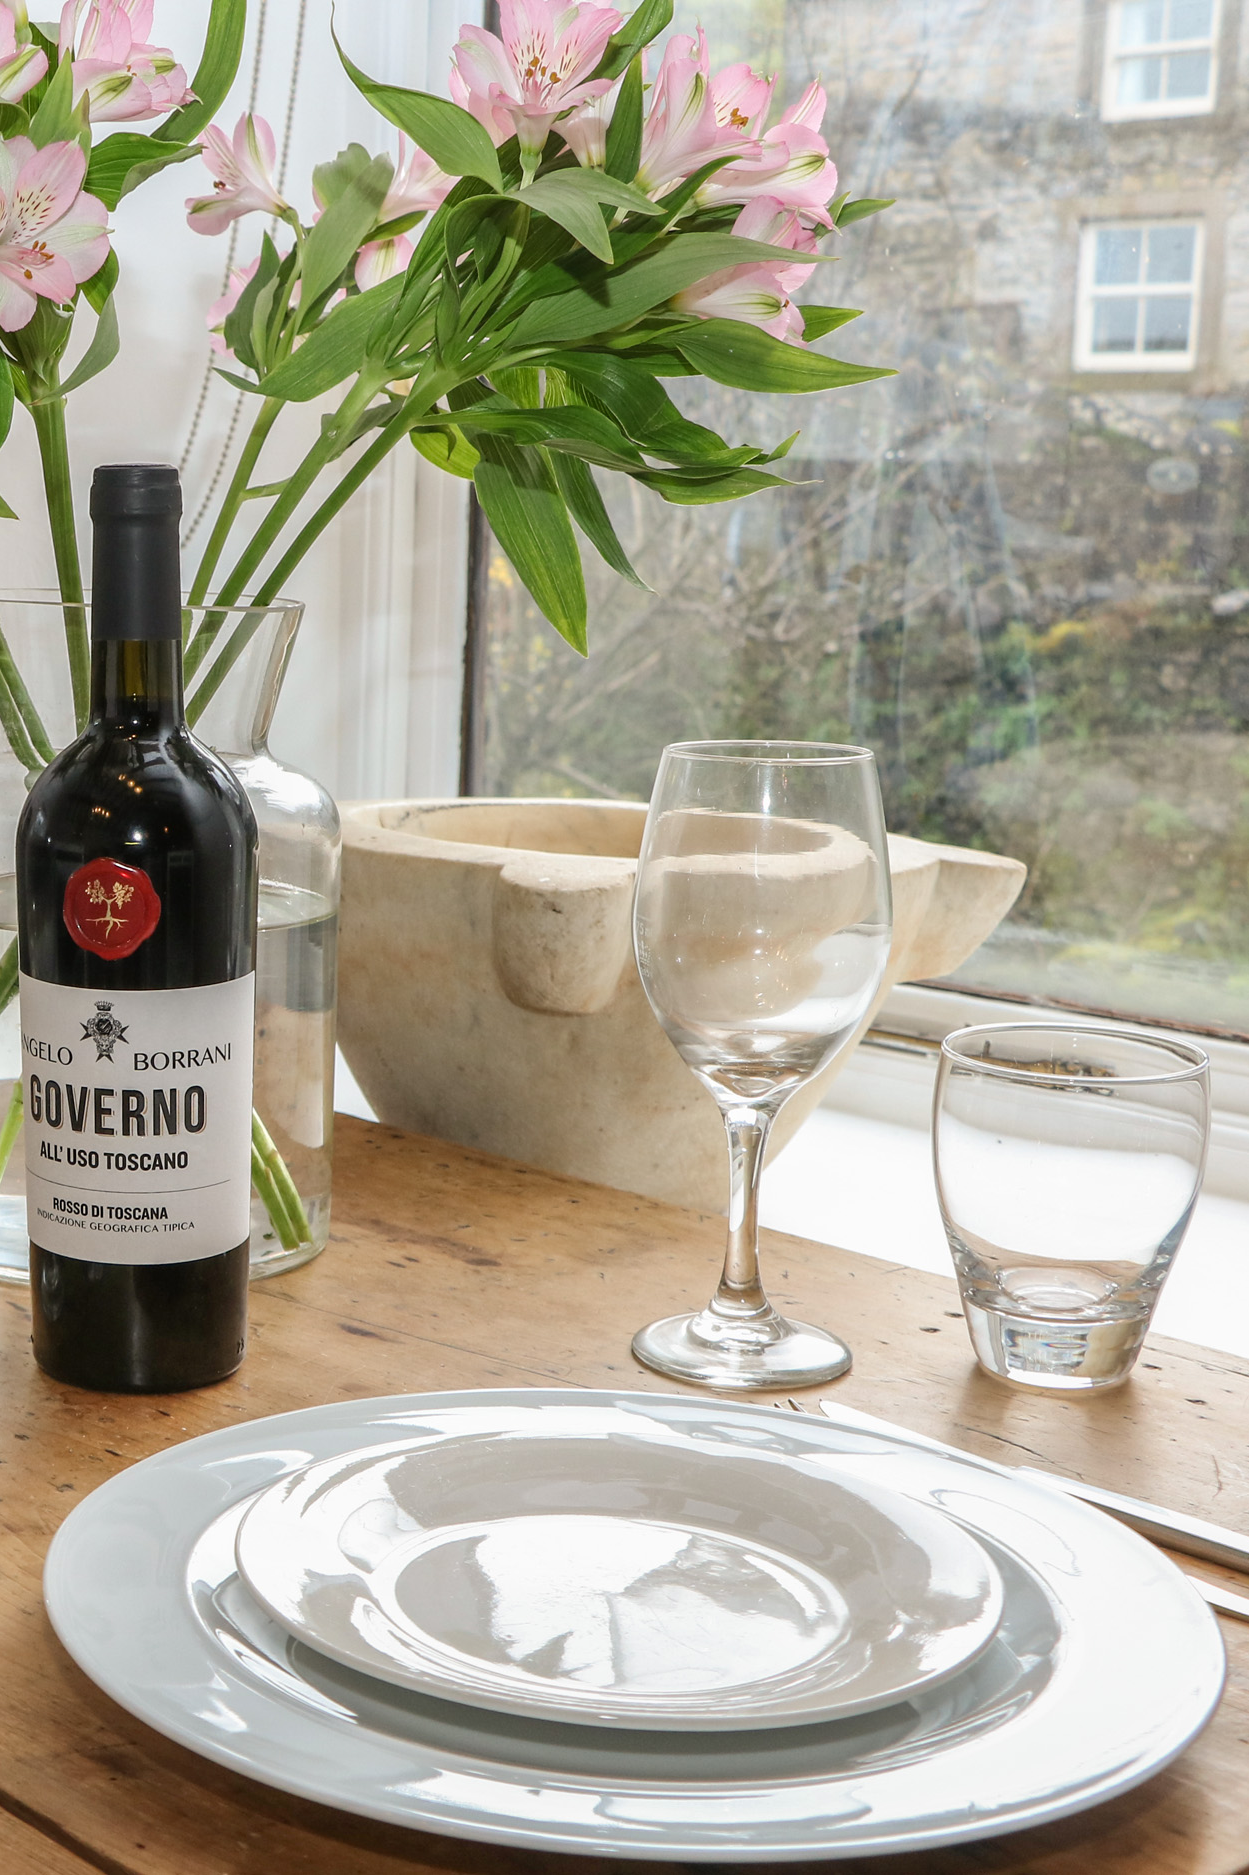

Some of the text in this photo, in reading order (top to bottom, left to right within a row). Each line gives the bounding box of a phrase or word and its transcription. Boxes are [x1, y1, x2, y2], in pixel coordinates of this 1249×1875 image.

[22, 1033, 231, 1071] NGELO BORRANI
[30, 1074, 208, 1137] GOVERNO
[40, 1140, 189, 1171] ALL' USO TOSCANO
[37, 1207, 195, 1234] INDICAZIONE GEOGRAFICA TIPICA
[53, 1197, 169, 1221] ROSSO DI TOSCANA
